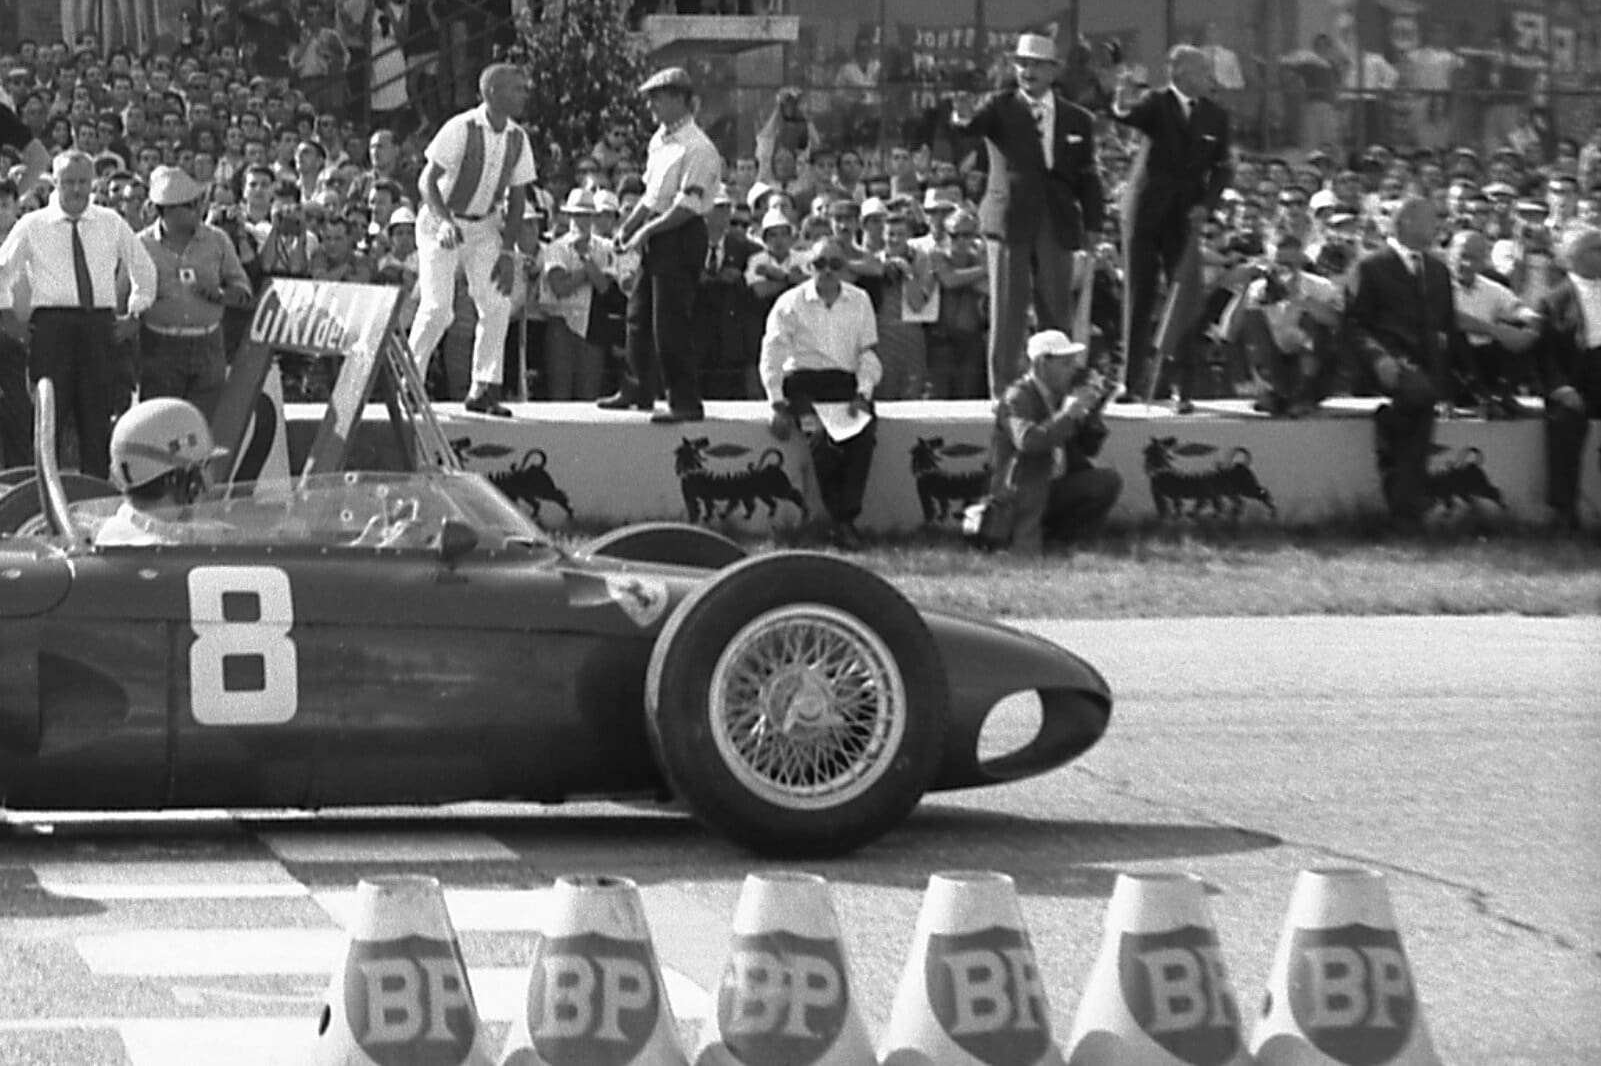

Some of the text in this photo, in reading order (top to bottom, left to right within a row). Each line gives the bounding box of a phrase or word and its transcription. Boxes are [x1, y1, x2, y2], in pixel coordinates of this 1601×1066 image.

[188, 565, 298, 725] 8
[359, 956, 466, 1043] BP
[534, 954, 652, 1041] BP
[728, 949, 842, 1038] BP
[1302, 945, 1409, 1029] BP
